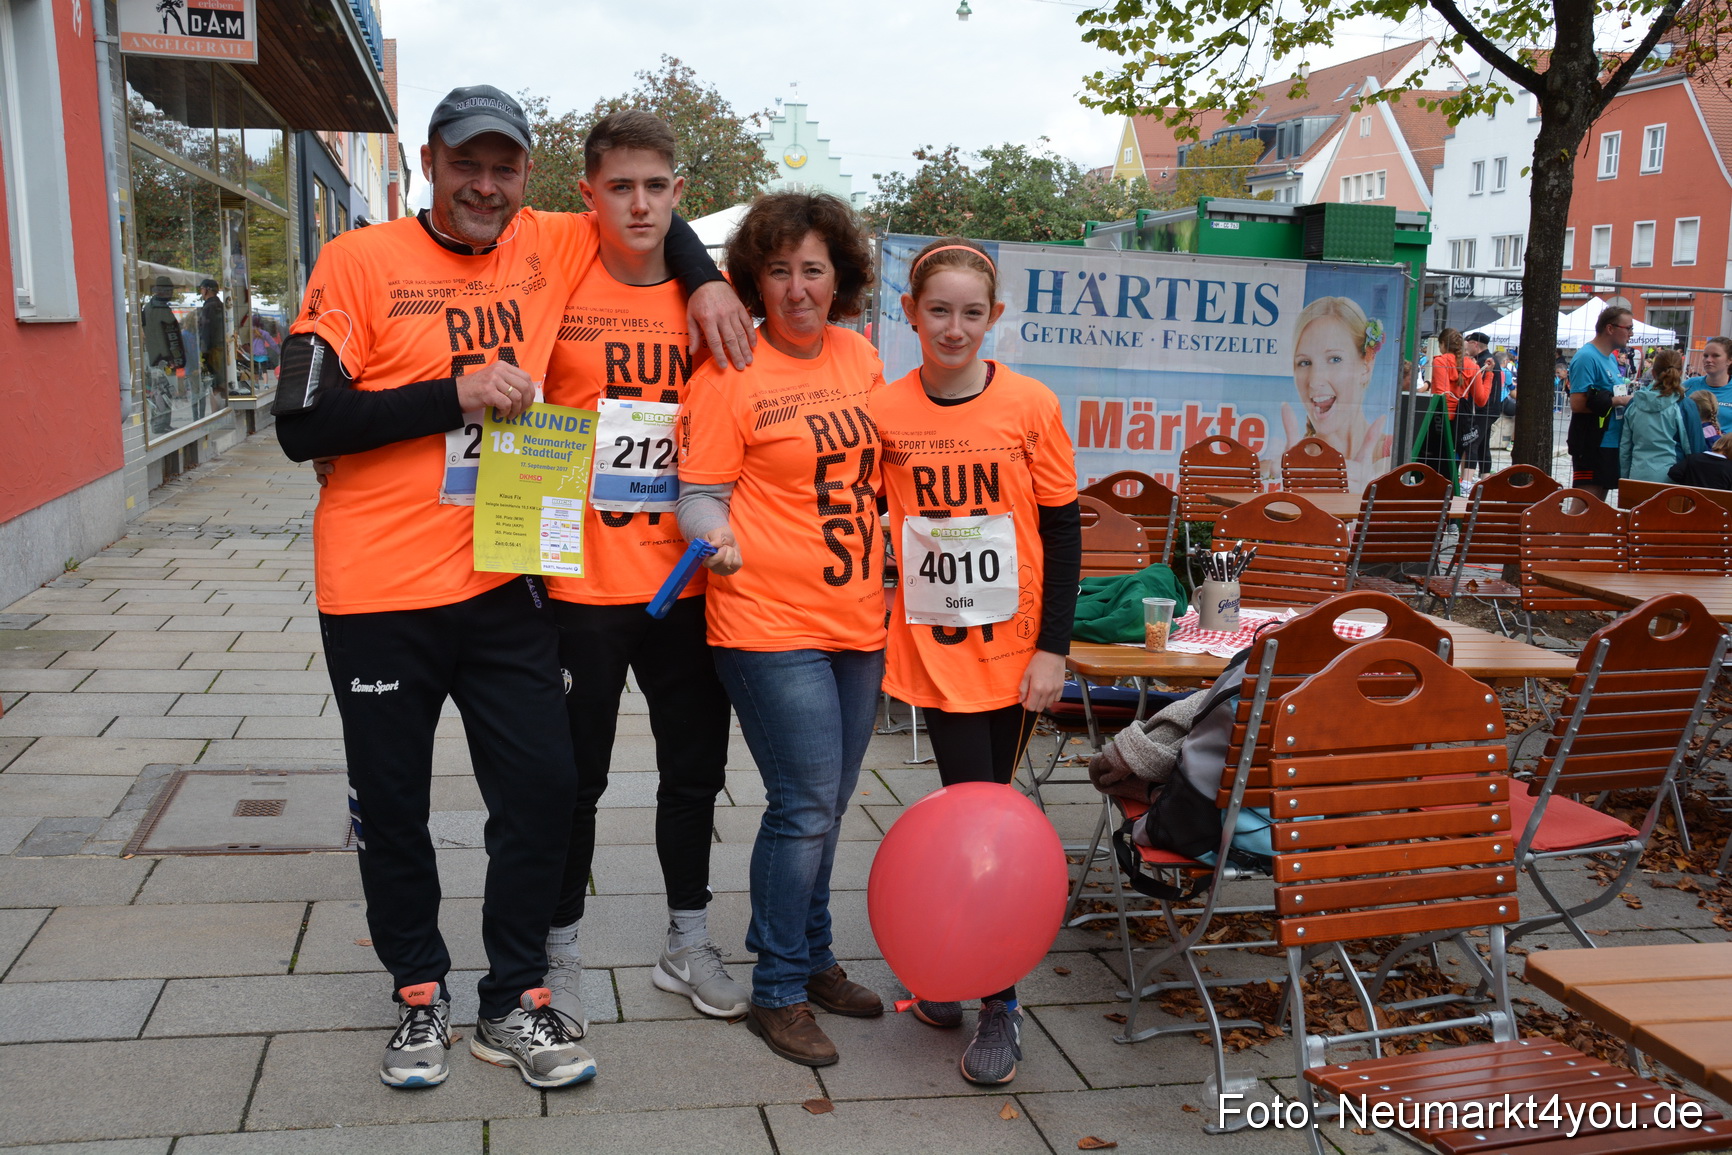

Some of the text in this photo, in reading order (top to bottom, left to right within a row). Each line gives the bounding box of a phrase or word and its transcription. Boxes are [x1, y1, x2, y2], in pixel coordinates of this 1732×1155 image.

[198, 0, 234, 10] erleben
[129, 37, 247, 56] ANGELGERÄTE
[390, 288, 424, 299] URBAN
[427, 288, 456, 299] SPORT
[521, 277, 547, 295] SPEED
[1454, 276, 1472, 289] KBK
[1021, 268, 1281, 327] HÄRTEIS
[446, 300, 524, 352] RUN
[587, 315, 618, 327] SPORT
[621, 318, 649, 328] VIBES
[1020, 321, 1278, 355] GETRÄNKE FESTZELTE
[604, 341, 693, 387] RUN
[752, 398, 780, 413] URBAN
[780, 393, 806, 405] SPORT
[806, 388, 830, 400] VIBES
[804, 406, 881, 454] RUN
[1077, 400, 1266, 454] Märkte
[490, 430, 587, 455] 18. Neumarkter
[898, 440, 926, 450] SPORT
[929, 439, 955, 449] VIBES
[521, 446, 573, 463] Stadtlauf
[520, 473, 537, 481] DKMS
[629, 481, 667, 494] Manuel
[814, 447, 876, 517] EA
[912, 462, 1000, 507] RUN
[941, 527, 982, 538] BOCK
[821, 511, 875, 588] SY
[919, 549, 1000, 584] 4010
[945, 597, 974, 609] Sofia
